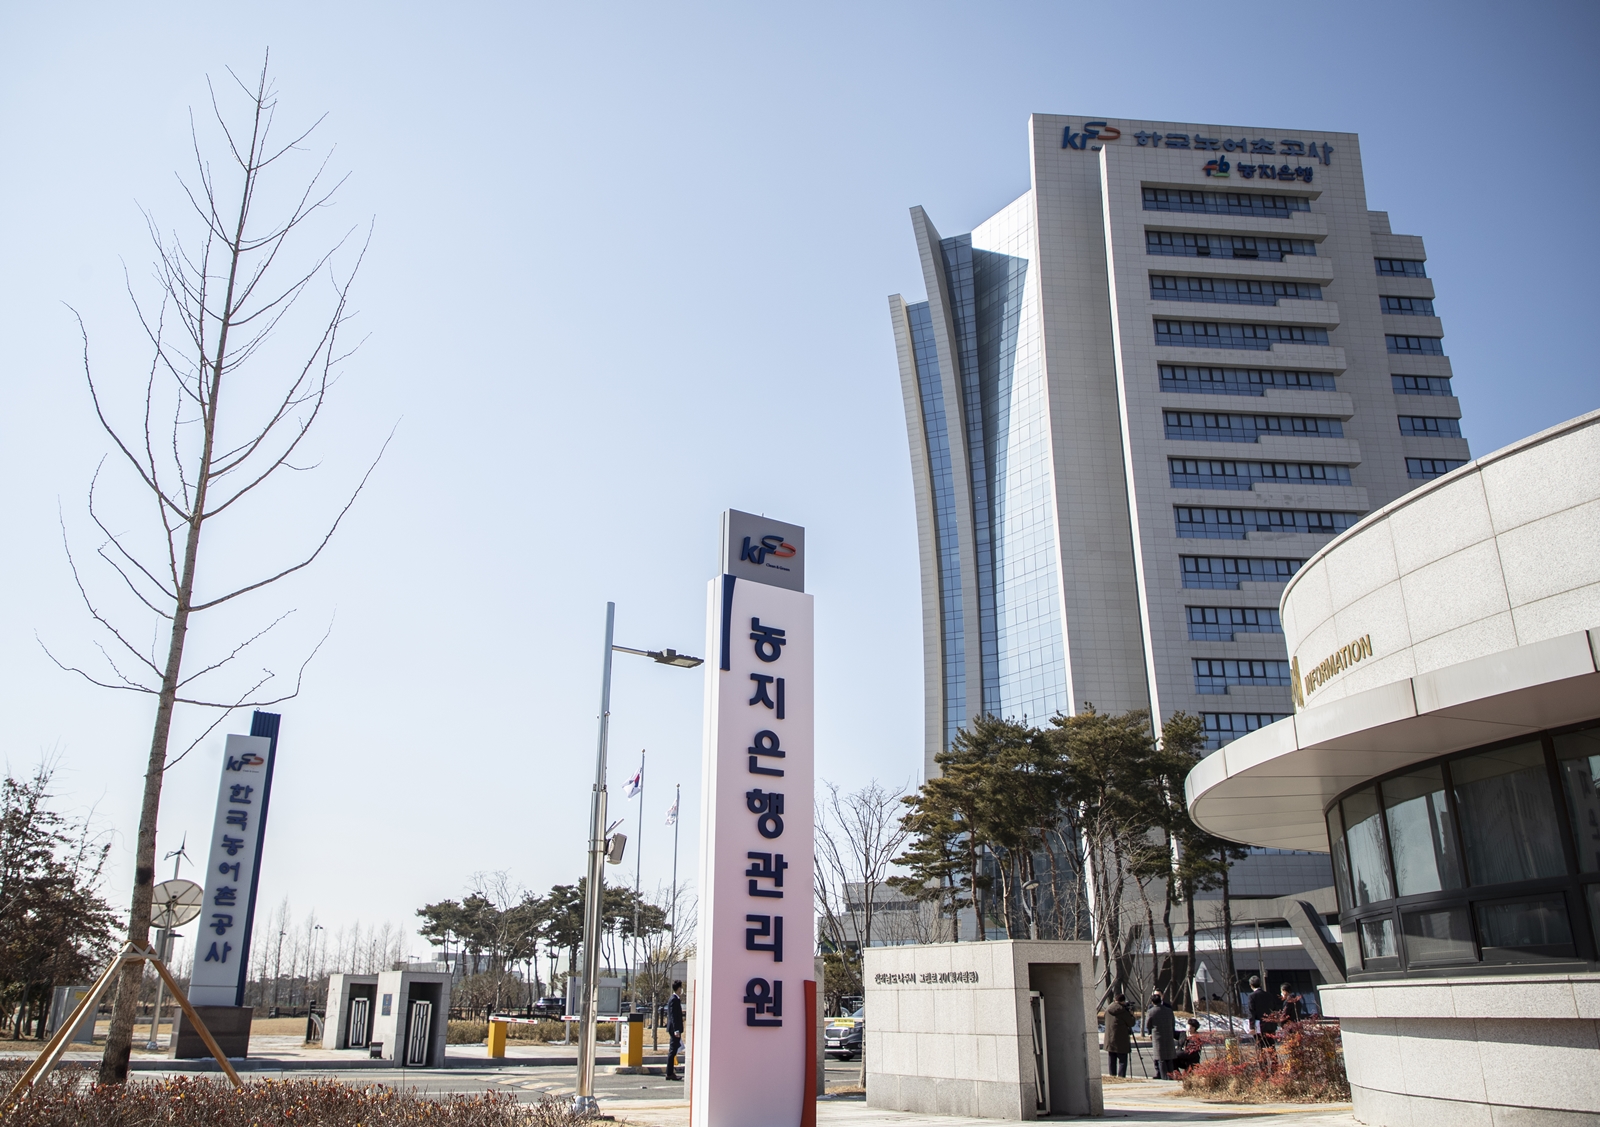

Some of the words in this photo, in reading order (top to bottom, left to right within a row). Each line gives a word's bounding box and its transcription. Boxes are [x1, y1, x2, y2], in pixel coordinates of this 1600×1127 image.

[1237, 161, 1314, 183] 농지은행
[1304, 633, 1373, 696] INFORMATION
[204, 783, 254, 964] 한국농어촌공사
[743, 616, 789, 1028] 농지은행관리원
